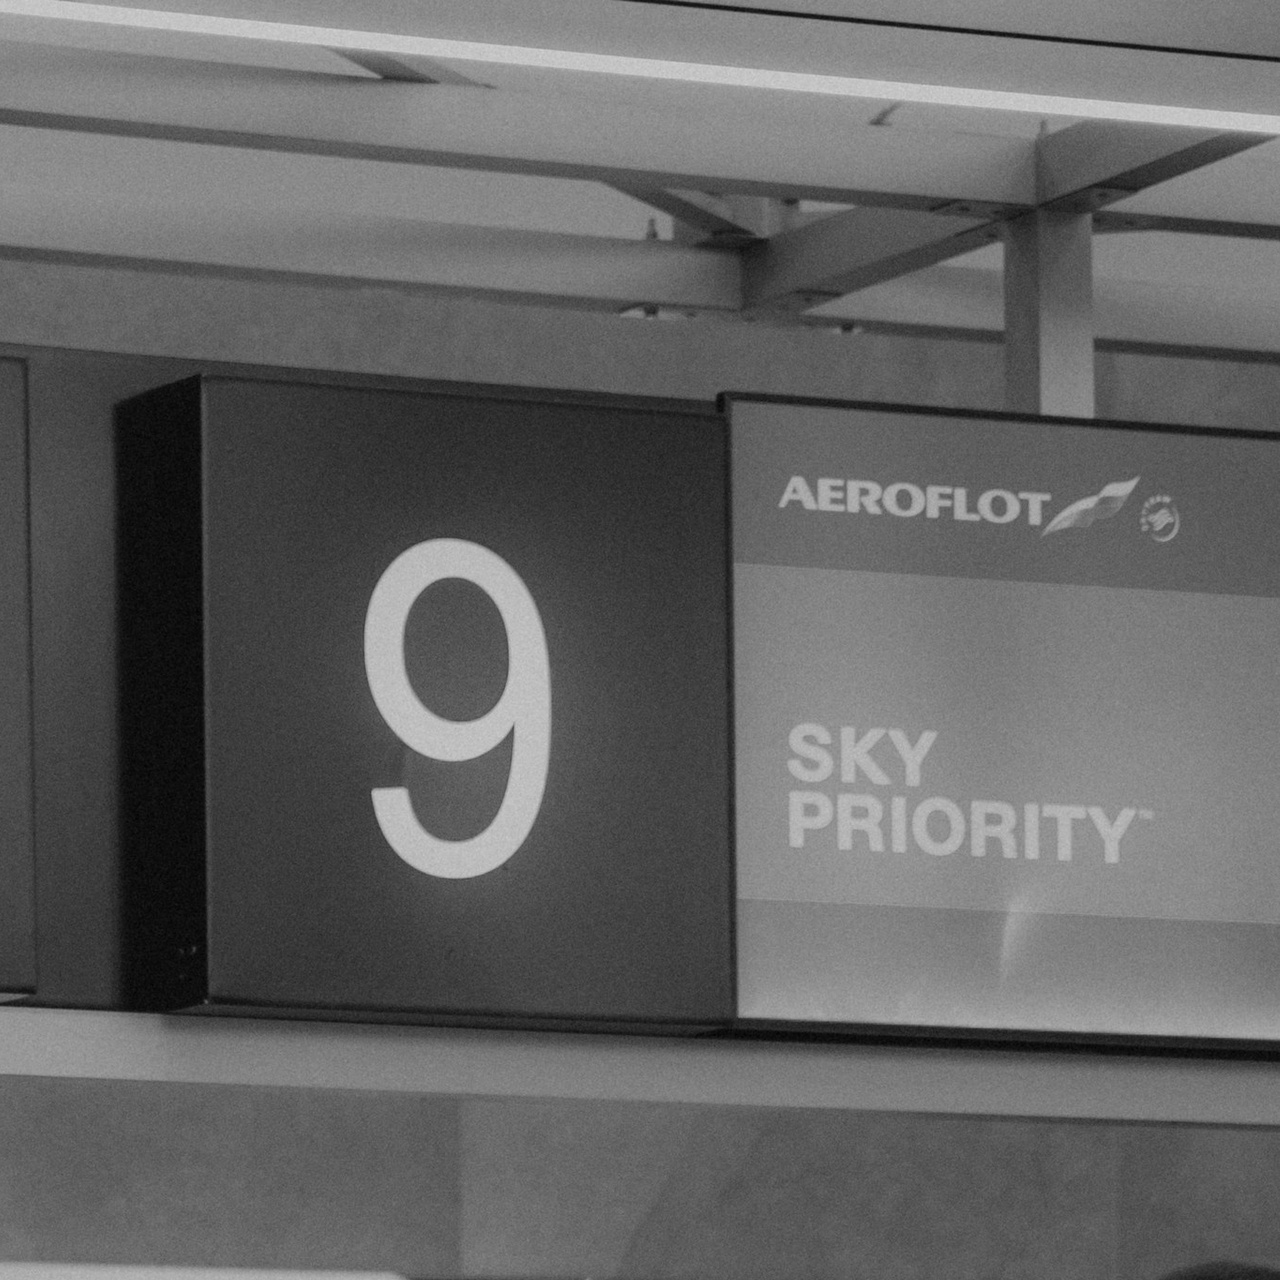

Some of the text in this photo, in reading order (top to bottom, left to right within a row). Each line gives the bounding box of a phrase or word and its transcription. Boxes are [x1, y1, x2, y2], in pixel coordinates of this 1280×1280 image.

[778, 475, 1053, 525] AEROFLOT
[363, 537, 552, 879] 9
[787, 723, 938, 786] SKY
[788, 791, 1137, 863] PRIORITY
